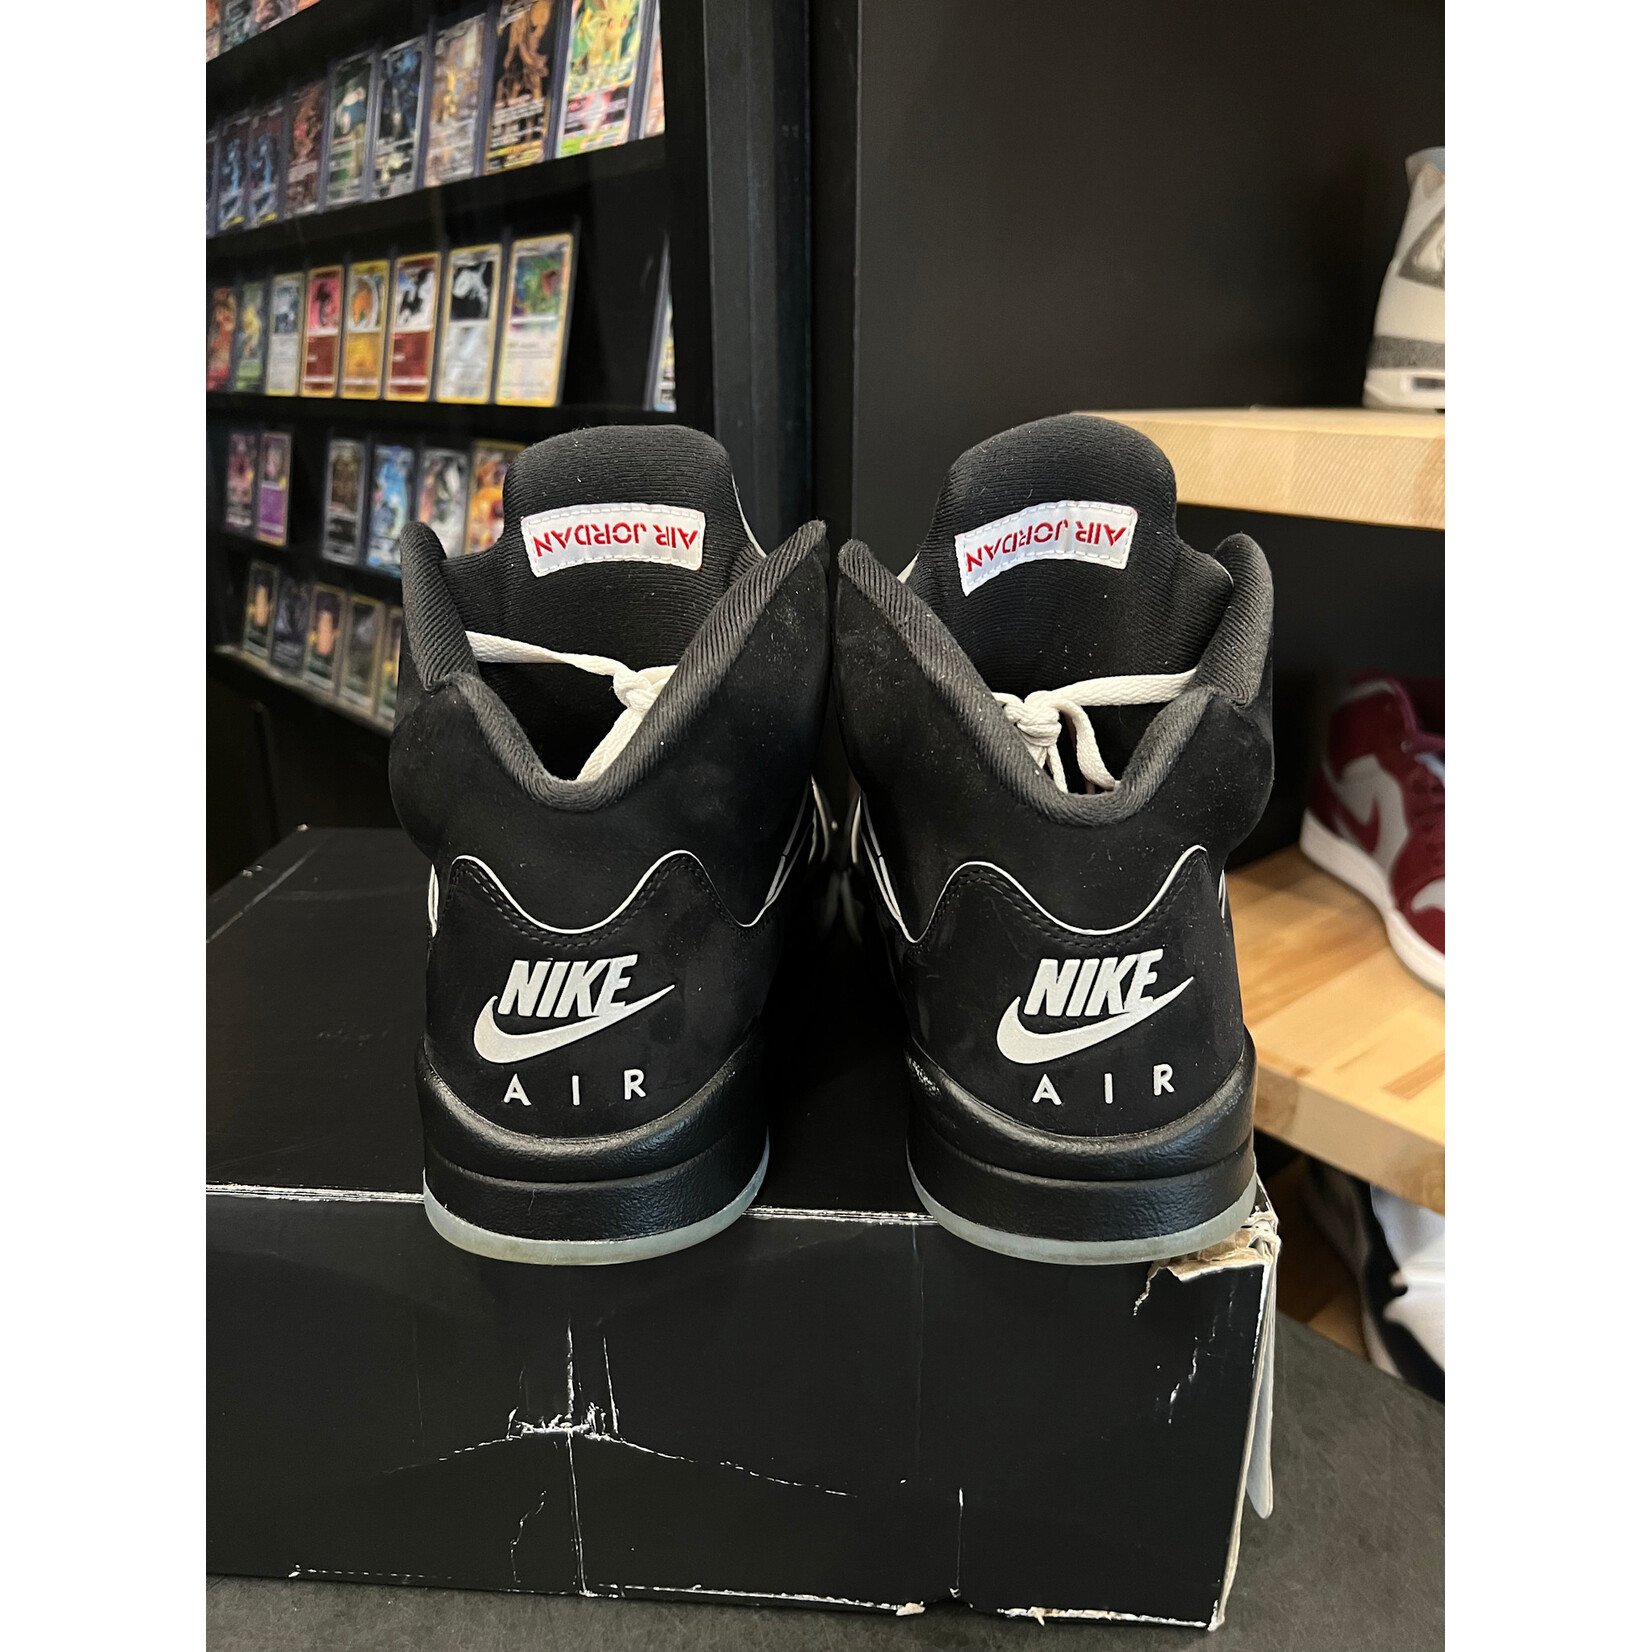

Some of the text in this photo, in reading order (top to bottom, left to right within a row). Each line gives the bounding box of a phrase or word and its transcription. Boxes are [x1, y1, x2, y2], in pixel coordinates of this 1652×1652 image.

[532, 521, 699, 558] AIR JORDAN
[965, 518, 1127, 573] AIR JORDAN
[497, 953, 639, 1018] NIKE
[1023, 948, 1164, 1017] NIKE
[503, 1068, 647, 1106] AIR
[1031, 1063, 1175, 1106] AIR
